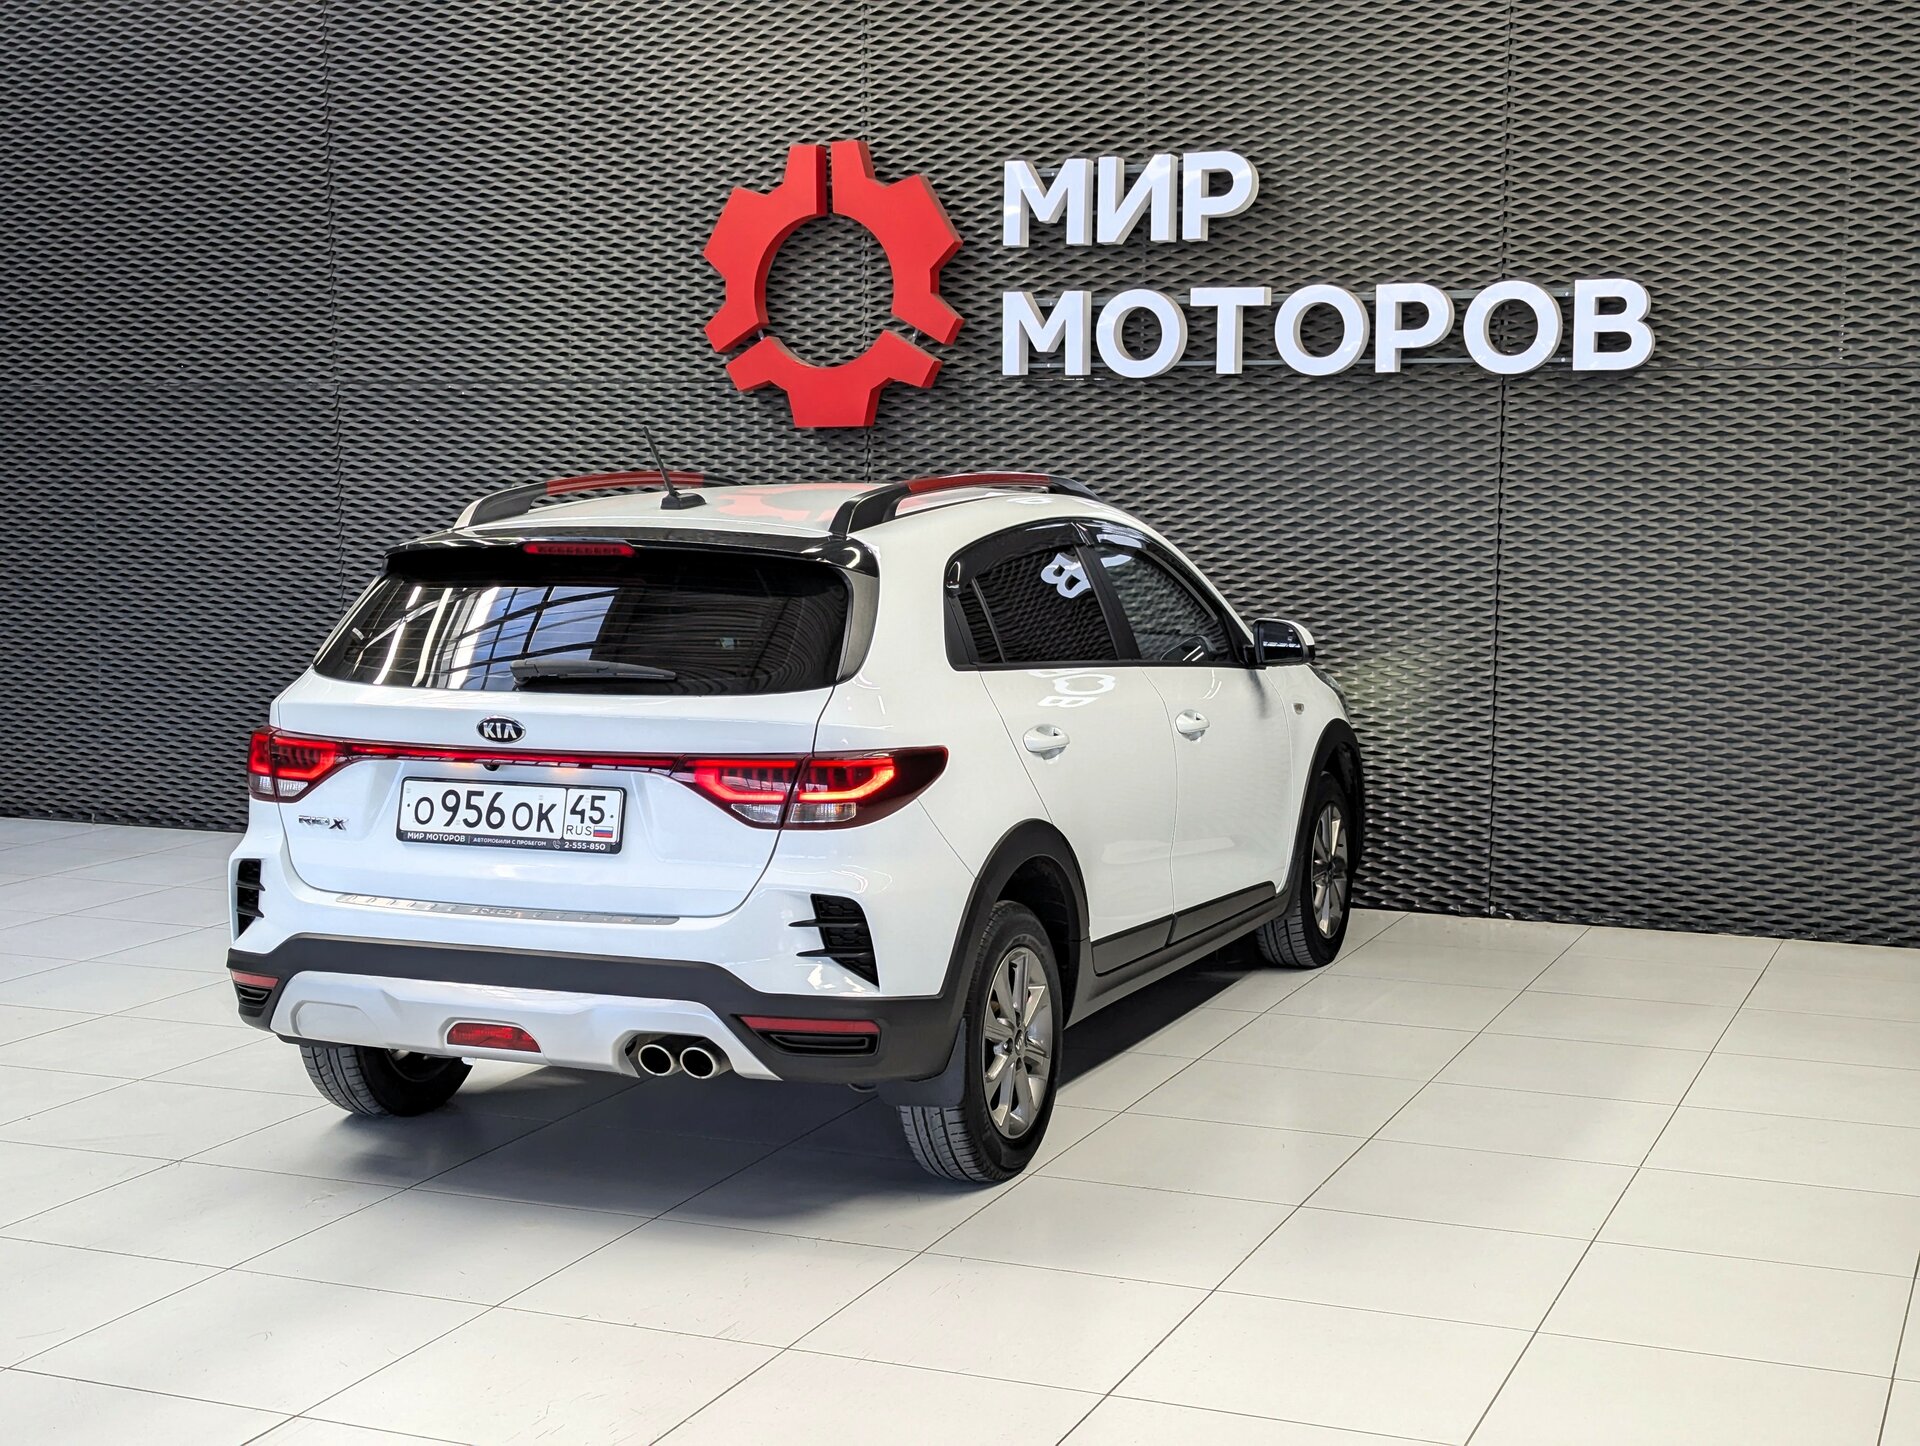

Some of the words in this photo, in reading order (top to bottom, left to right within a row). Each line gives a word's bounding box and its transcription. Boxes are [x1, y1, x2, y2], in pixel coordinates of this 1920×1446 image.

[1002, 150, 1259, 247] МИР
[1001, 278, 1655, 379] МОТОРОВ
[483, 721, 518, 739] KIA
[569, 794, 607, 825] 45
[407, 832, 425, 840] МИР
[425, 833, 466, 843] МОТОРОВ
[472, 837, 511, 845] АВТОМОБИЛИ
[564, 841, 606, 851] 2-555-850
[565, 825, 592, 836] RUS
